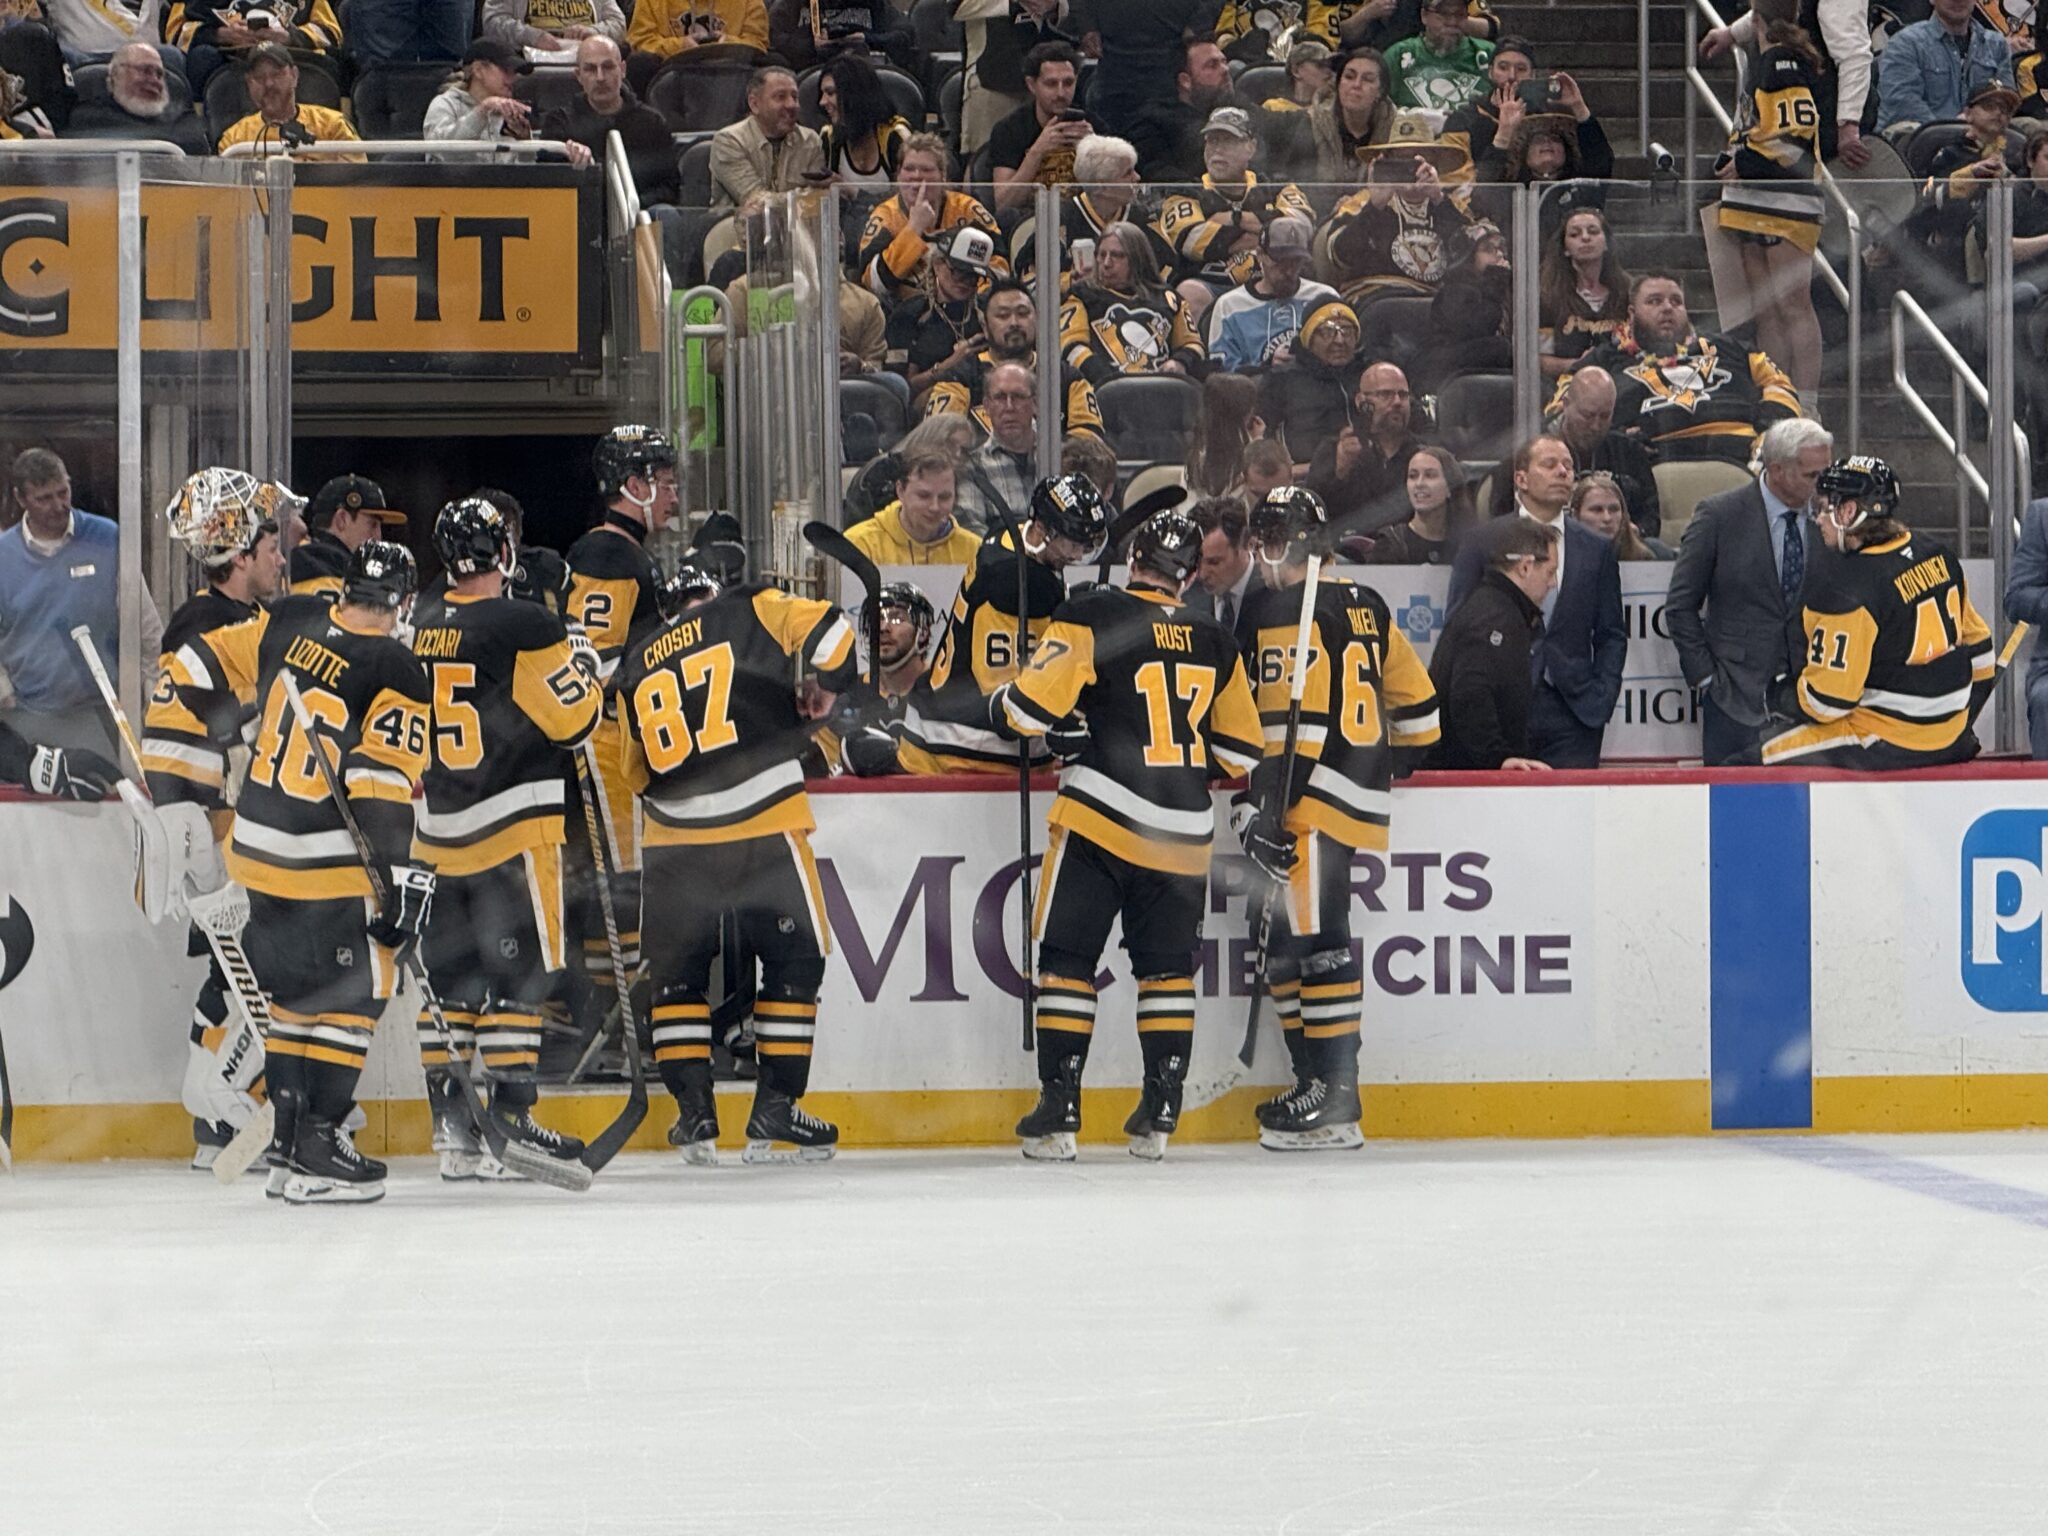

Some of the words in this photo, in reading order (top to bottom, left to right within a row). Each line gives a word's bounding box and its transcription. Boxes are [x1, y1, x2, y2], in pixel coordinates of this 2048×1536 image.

[1777, 99, 1815, 128] 16
[1165, 201, 1193, 229] 58
[1894, 555, 1950, 603] KOIVUNEN
[584, 592, 613, 628] 2
[643, 617, 703, 670] CROSBY
[1152, 622, 1192, 653] RUST
[1809, 624, 1849, 671] 41
[284, 635, 349, 689] LIZOTTE
[371, 706, 426, 755] 46
[634, 641, 738, 774] 87
[1134, 661, 1217, 768] 17
[250, 667, 349, 803] 46
